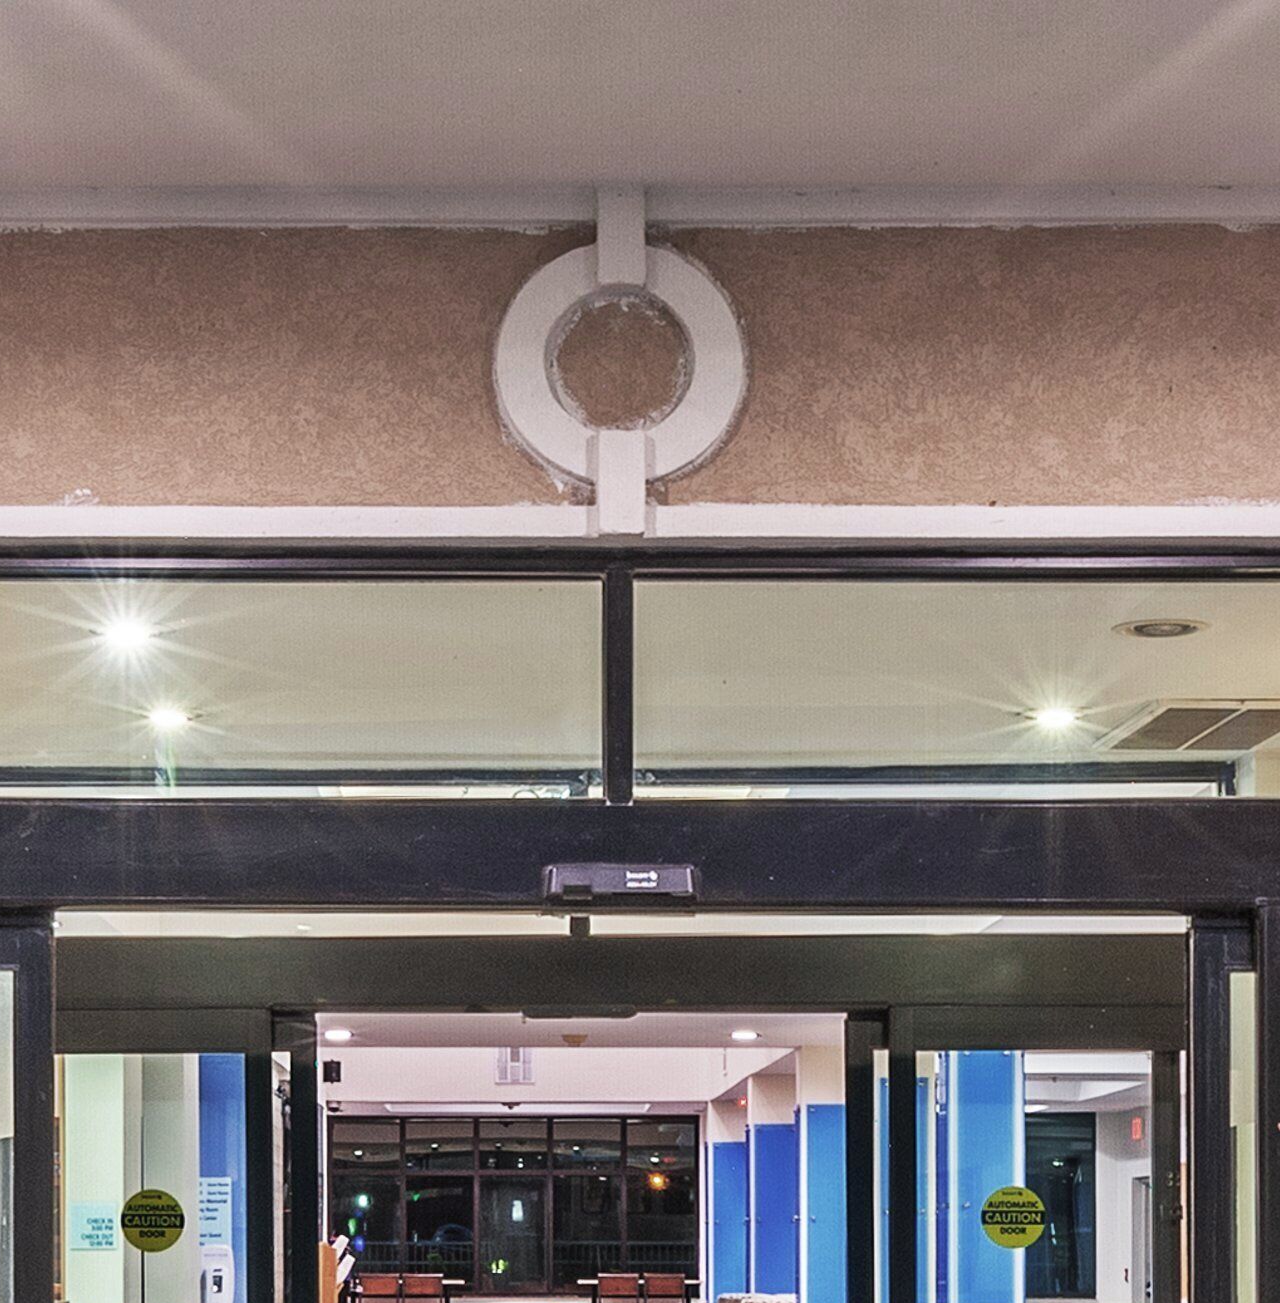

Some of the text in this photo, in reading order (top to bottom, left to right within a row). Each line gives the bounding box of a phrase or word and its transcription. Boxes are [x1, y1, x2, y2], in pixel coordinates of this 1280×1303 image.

[126, 1204, 178, 1213] AUTOMATIC
[987, 1201, 1039, 1209] AUTOMATIC
[86, 1217, 106, 1225] CHECK
[124, 1215, 180, 1226] CAUTION
[985, 1212, 1041, 1224] CAUTION
[138, 1229, 166, 1238] DOOR
[1000, 1227, 1027, 1235] DOOR
[80, 1233, 114, 1241] CHECK OUT
